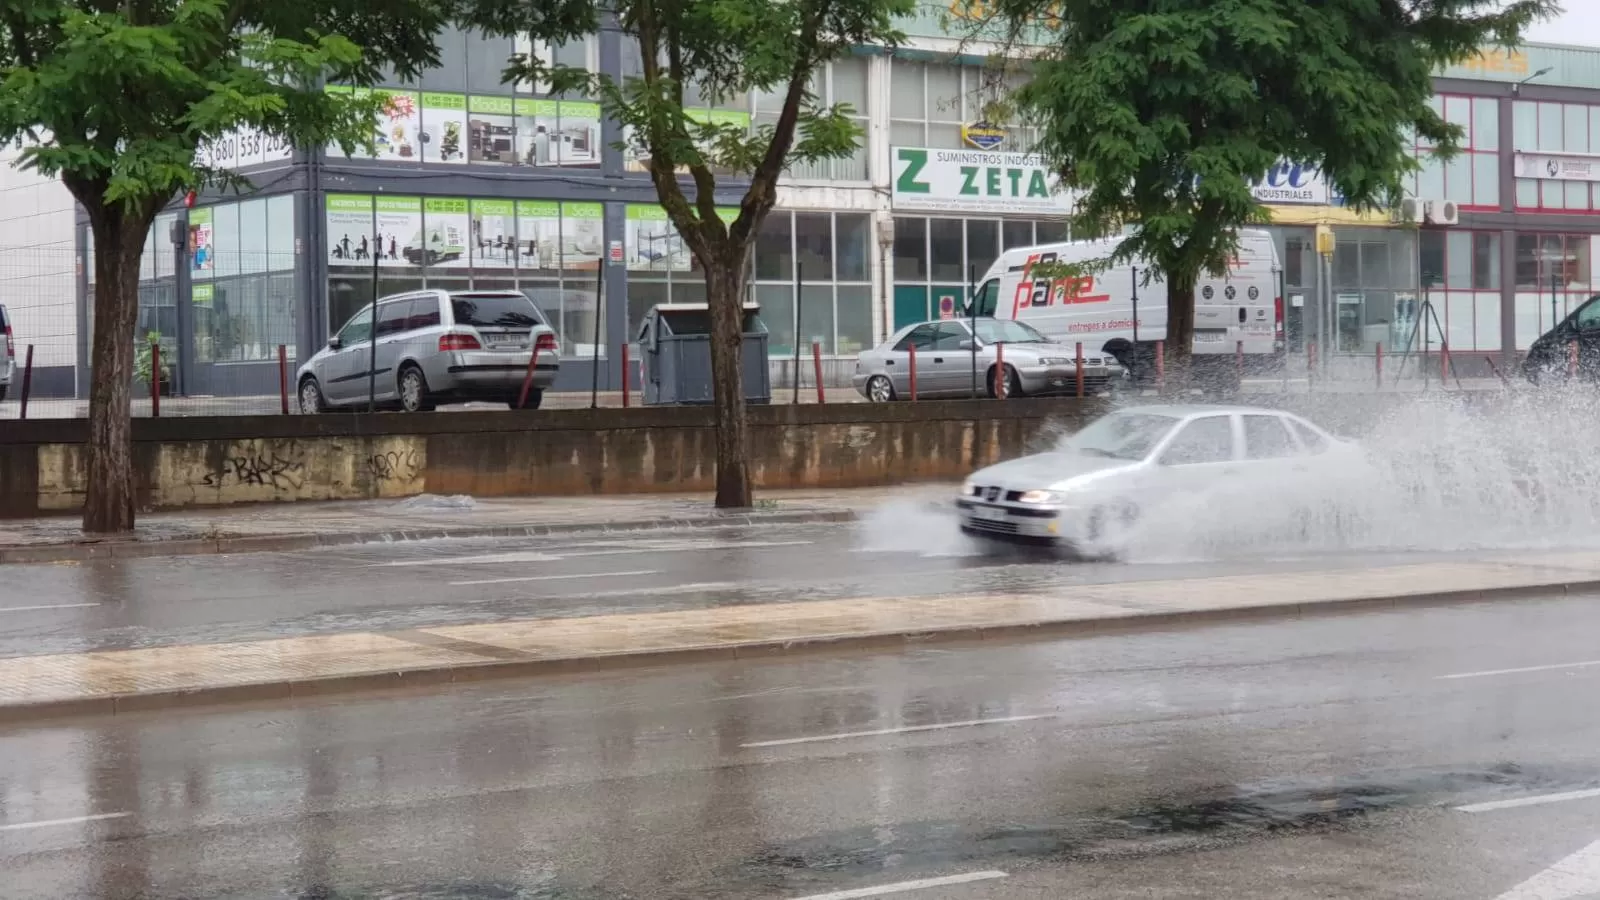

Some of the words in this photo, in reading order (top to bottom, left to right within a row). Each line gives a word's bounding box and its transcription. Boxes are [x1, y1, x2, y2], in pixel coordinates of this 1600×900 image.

[215, 138, 234, 161] 680
[240, 132, 260, 156] 558
[937, 151, 1002, 165] SUMINISTROS
[897, 149, 931, 193] Z
[959, 166, 1049, 198] ZETA
[1254, 189, 1313, 200] INDUSTRIALES
